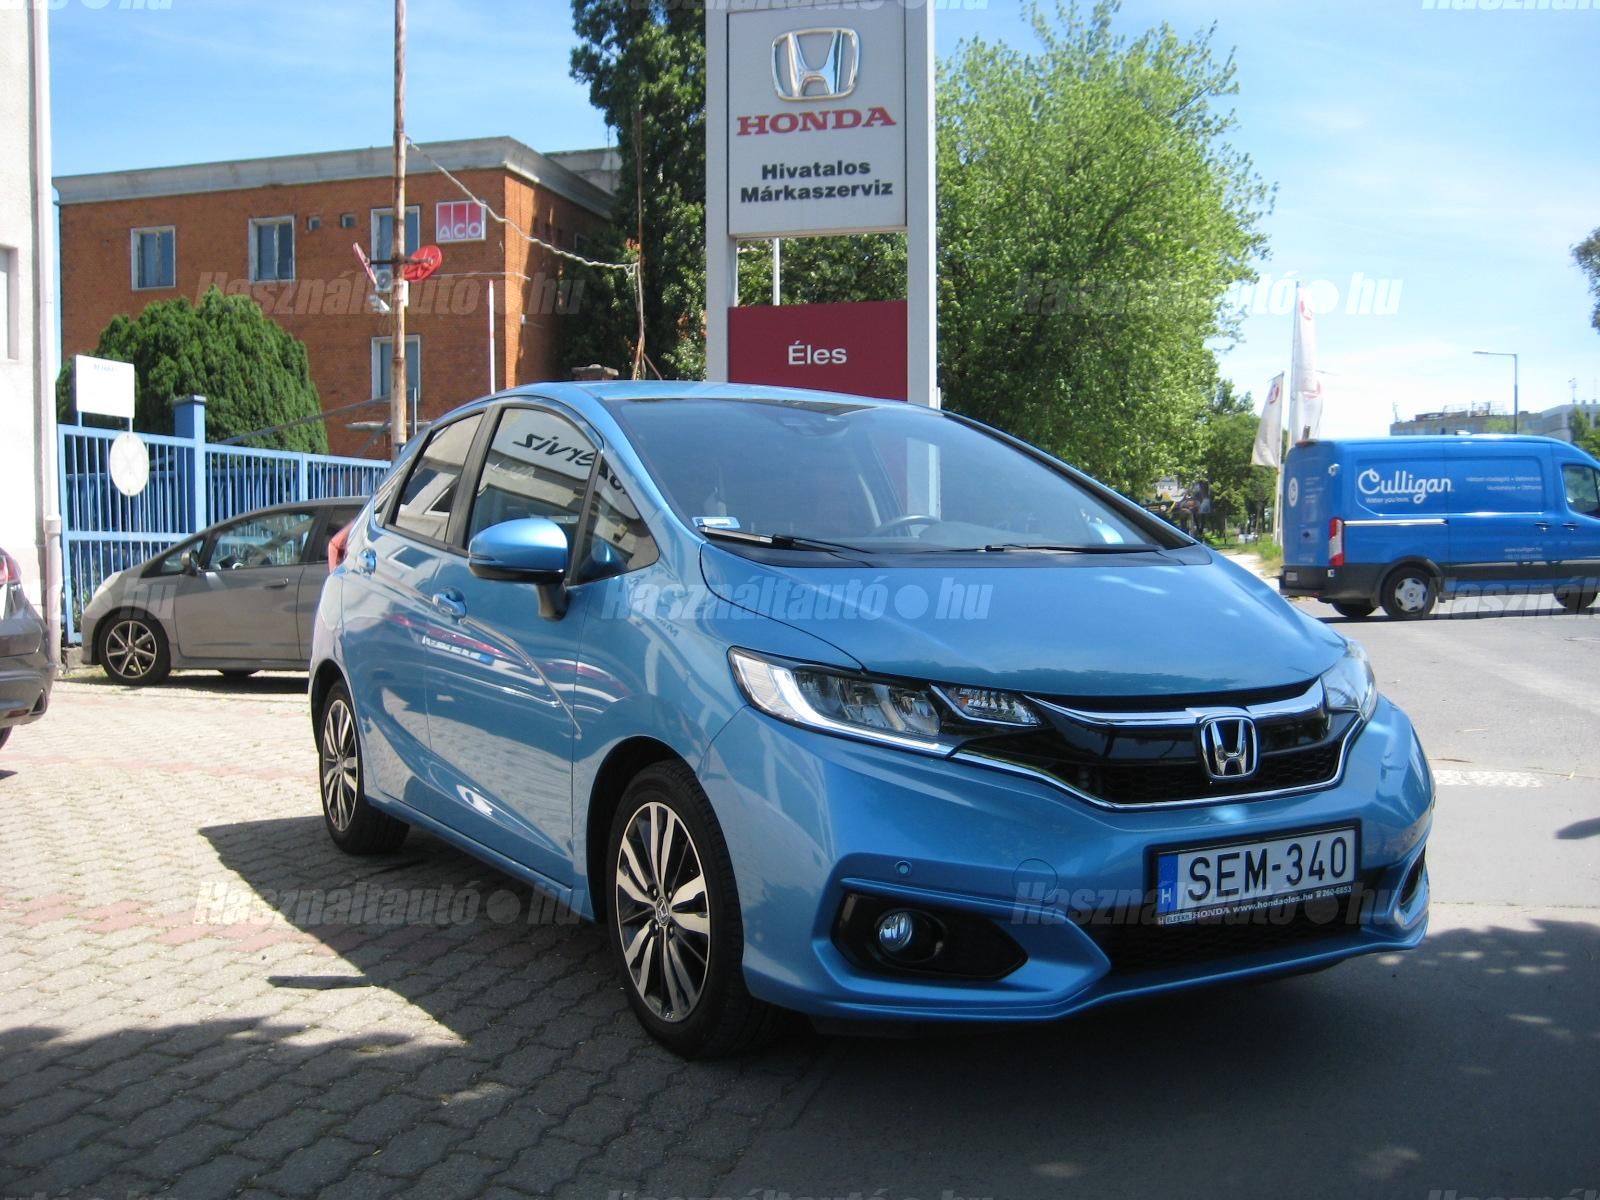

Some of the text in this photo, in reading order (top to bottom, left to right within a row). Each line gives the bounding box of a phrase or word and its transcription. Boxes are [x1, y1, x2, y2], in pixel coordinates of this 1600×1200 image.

[736, 107, 896, 136] HONDA
[761, 160, 871, 180] Hivatalos
[740, 179, 893, 203] Márkaszerviz
[439, 222, 482, 240] ACO
[788, 340, 848, 365] Éles
[1358, 468, 1452, 504] Culligan
[1187, 836, 1347, 900] SEM-340
[1161, 888, 1172, 904] H
[1193, 906, 1231, 919] HONDA
